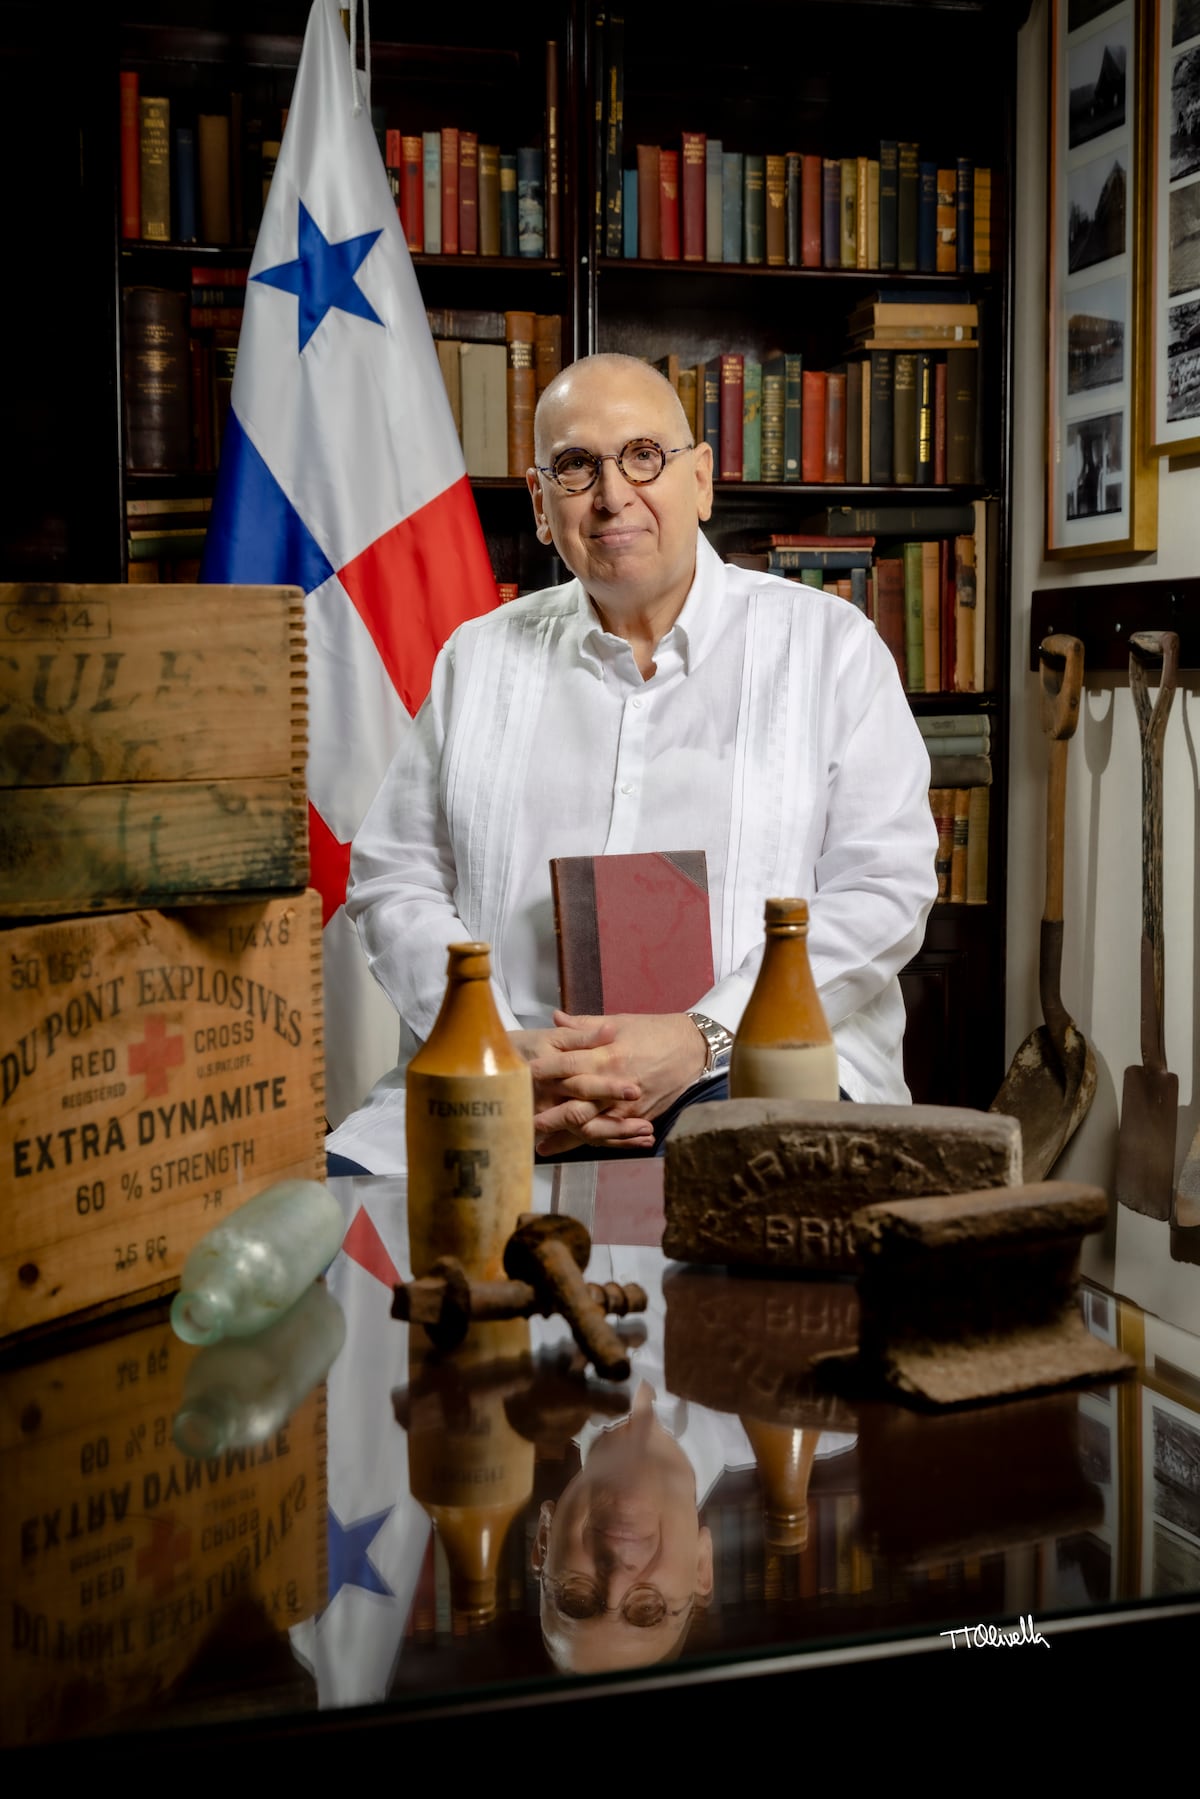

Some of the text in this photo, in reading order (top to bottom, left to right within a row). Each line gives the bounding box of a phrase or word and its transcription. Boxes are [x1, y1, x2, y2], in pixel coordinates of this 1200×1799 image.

[136, 965, 303, 1047] EXPLOSIVES
[194, 1020, 255, 1053] CROSS
[71, 1048, 117, 1081] RED
[14, 1076, 287, 1178] EXTRA DYNAMITE
[428, 1099, 504, 1117] TENNENT
[76, 1139, 255, 1215] 60 % STRENGTH
[444, 1149, 490, 1198] T
